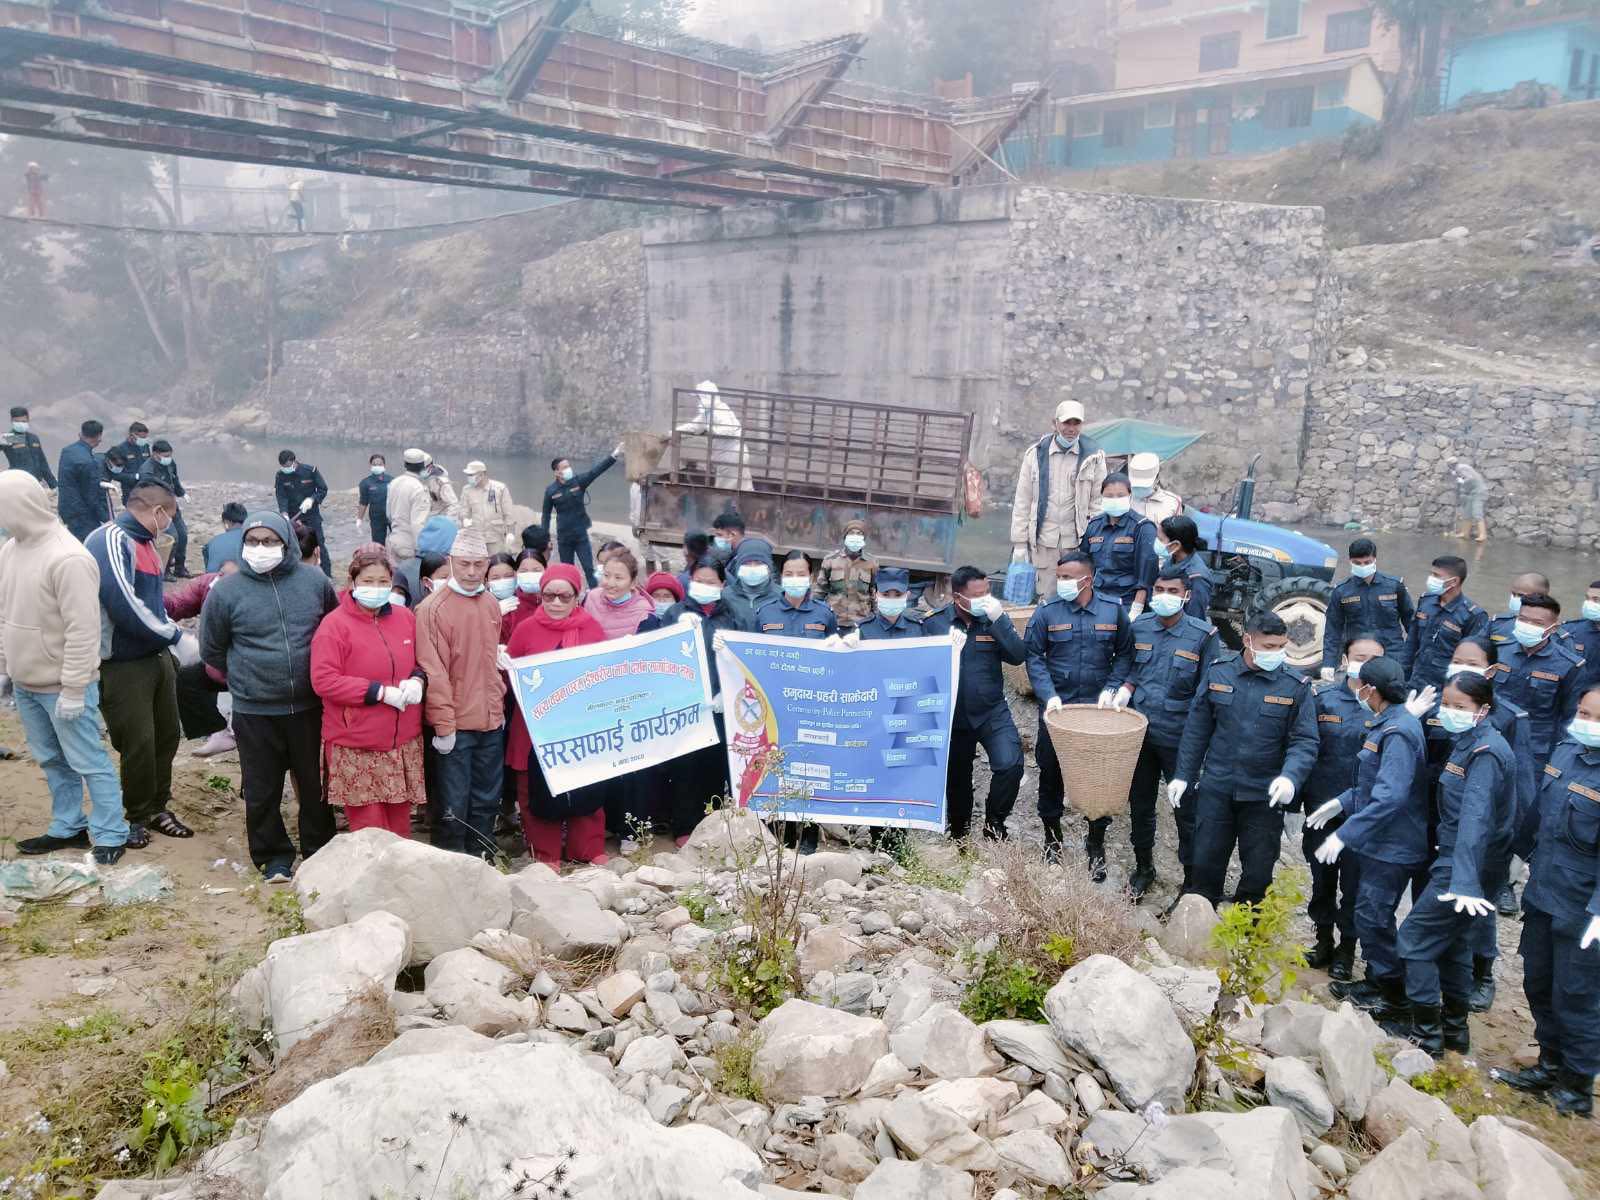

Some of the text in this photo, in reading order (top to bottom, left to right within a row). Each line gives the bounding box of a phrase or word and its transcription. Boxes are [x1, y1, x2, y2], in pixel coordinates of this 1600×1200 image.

[1235, 546, 1273, 559] NEW HOLLAND
[539, 702, 701, 770] सरसफाई कार्यक्रम
